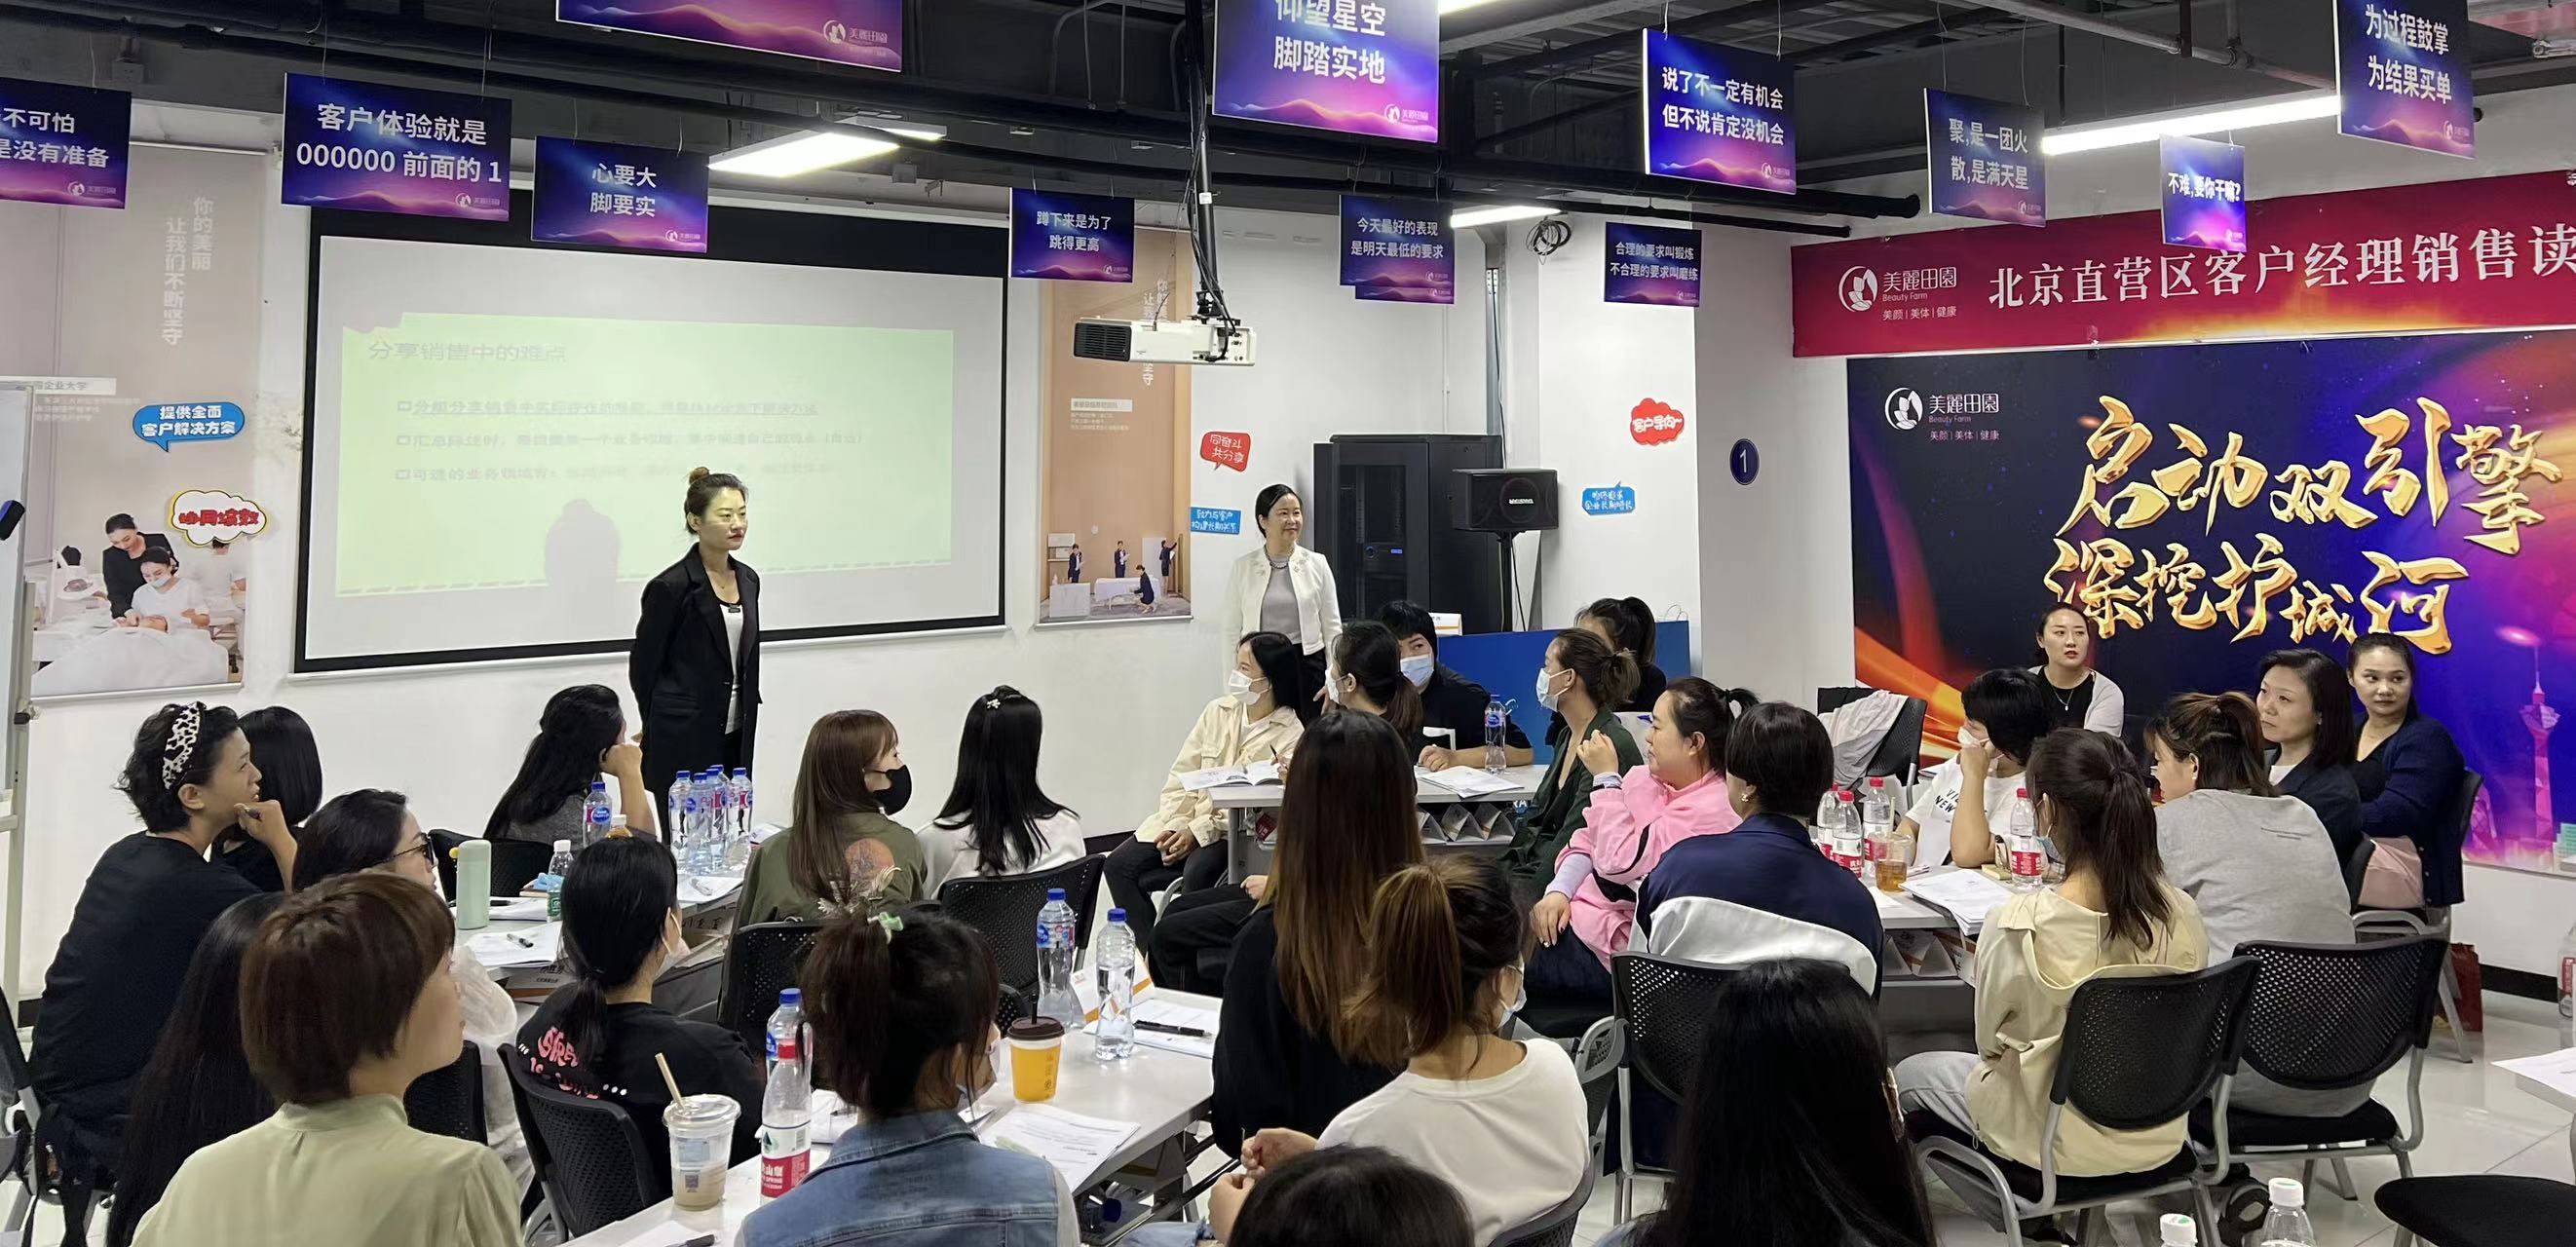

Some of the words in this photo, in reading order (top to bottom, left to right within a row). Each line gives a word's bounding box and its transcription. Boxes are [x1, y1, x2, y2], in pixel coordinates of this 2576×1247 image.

[2365, 4, 2450, 56] 为过程鼓掌
[1273, 35, 1386, 85] 脚踏实地
[1662, 66, 1784, 111] 说了不一定有机会
[2367, 55, 2453, 104] 为结果买单
[0, 107, 75, 133] 不可怕
[317, 102, 488, 146] 客户体验就是
[1662, 103, 1785, 146] 但不说肯定没机会
[295, 142, 397, 173] 000000
[402, 151, 482, 184] 前面的
[488, 161, 503, 184] 1
[591, 163, 658, 189] 心要大
[589, 191, 657, 218] 脚要实
[191, 197, 214, 271] 你的美丽
[1036, 211, 1113, 232] 蹲下来是为了
[1357, 217, 1439, 237] 今天最好的表现
[1048, 235, 1100, 252] 跳得更高
[1350, 240, 1444, 260] 是明天最低的要求
[1614, 242, 1694, 260] 合理的要求叫锻炼
[1610, 262, 1698, 281] 不合理的要求叫磨练
[1989, 222, 2576, 310] 北京直营区客户经理销售读
[1882, 293, 1909, 302] Beauty
[367, 341, 568, 361] 分享销售中的难点
[159, 405, 223, 420] 提供全面
[141, 421, 236, 436] 客户解决方案
[1739, 449, 1749, 473] 1
[2055, 396, 2563, 556] 启动双引擎
[2044, 533, 2470, 655] 深挖护城河
